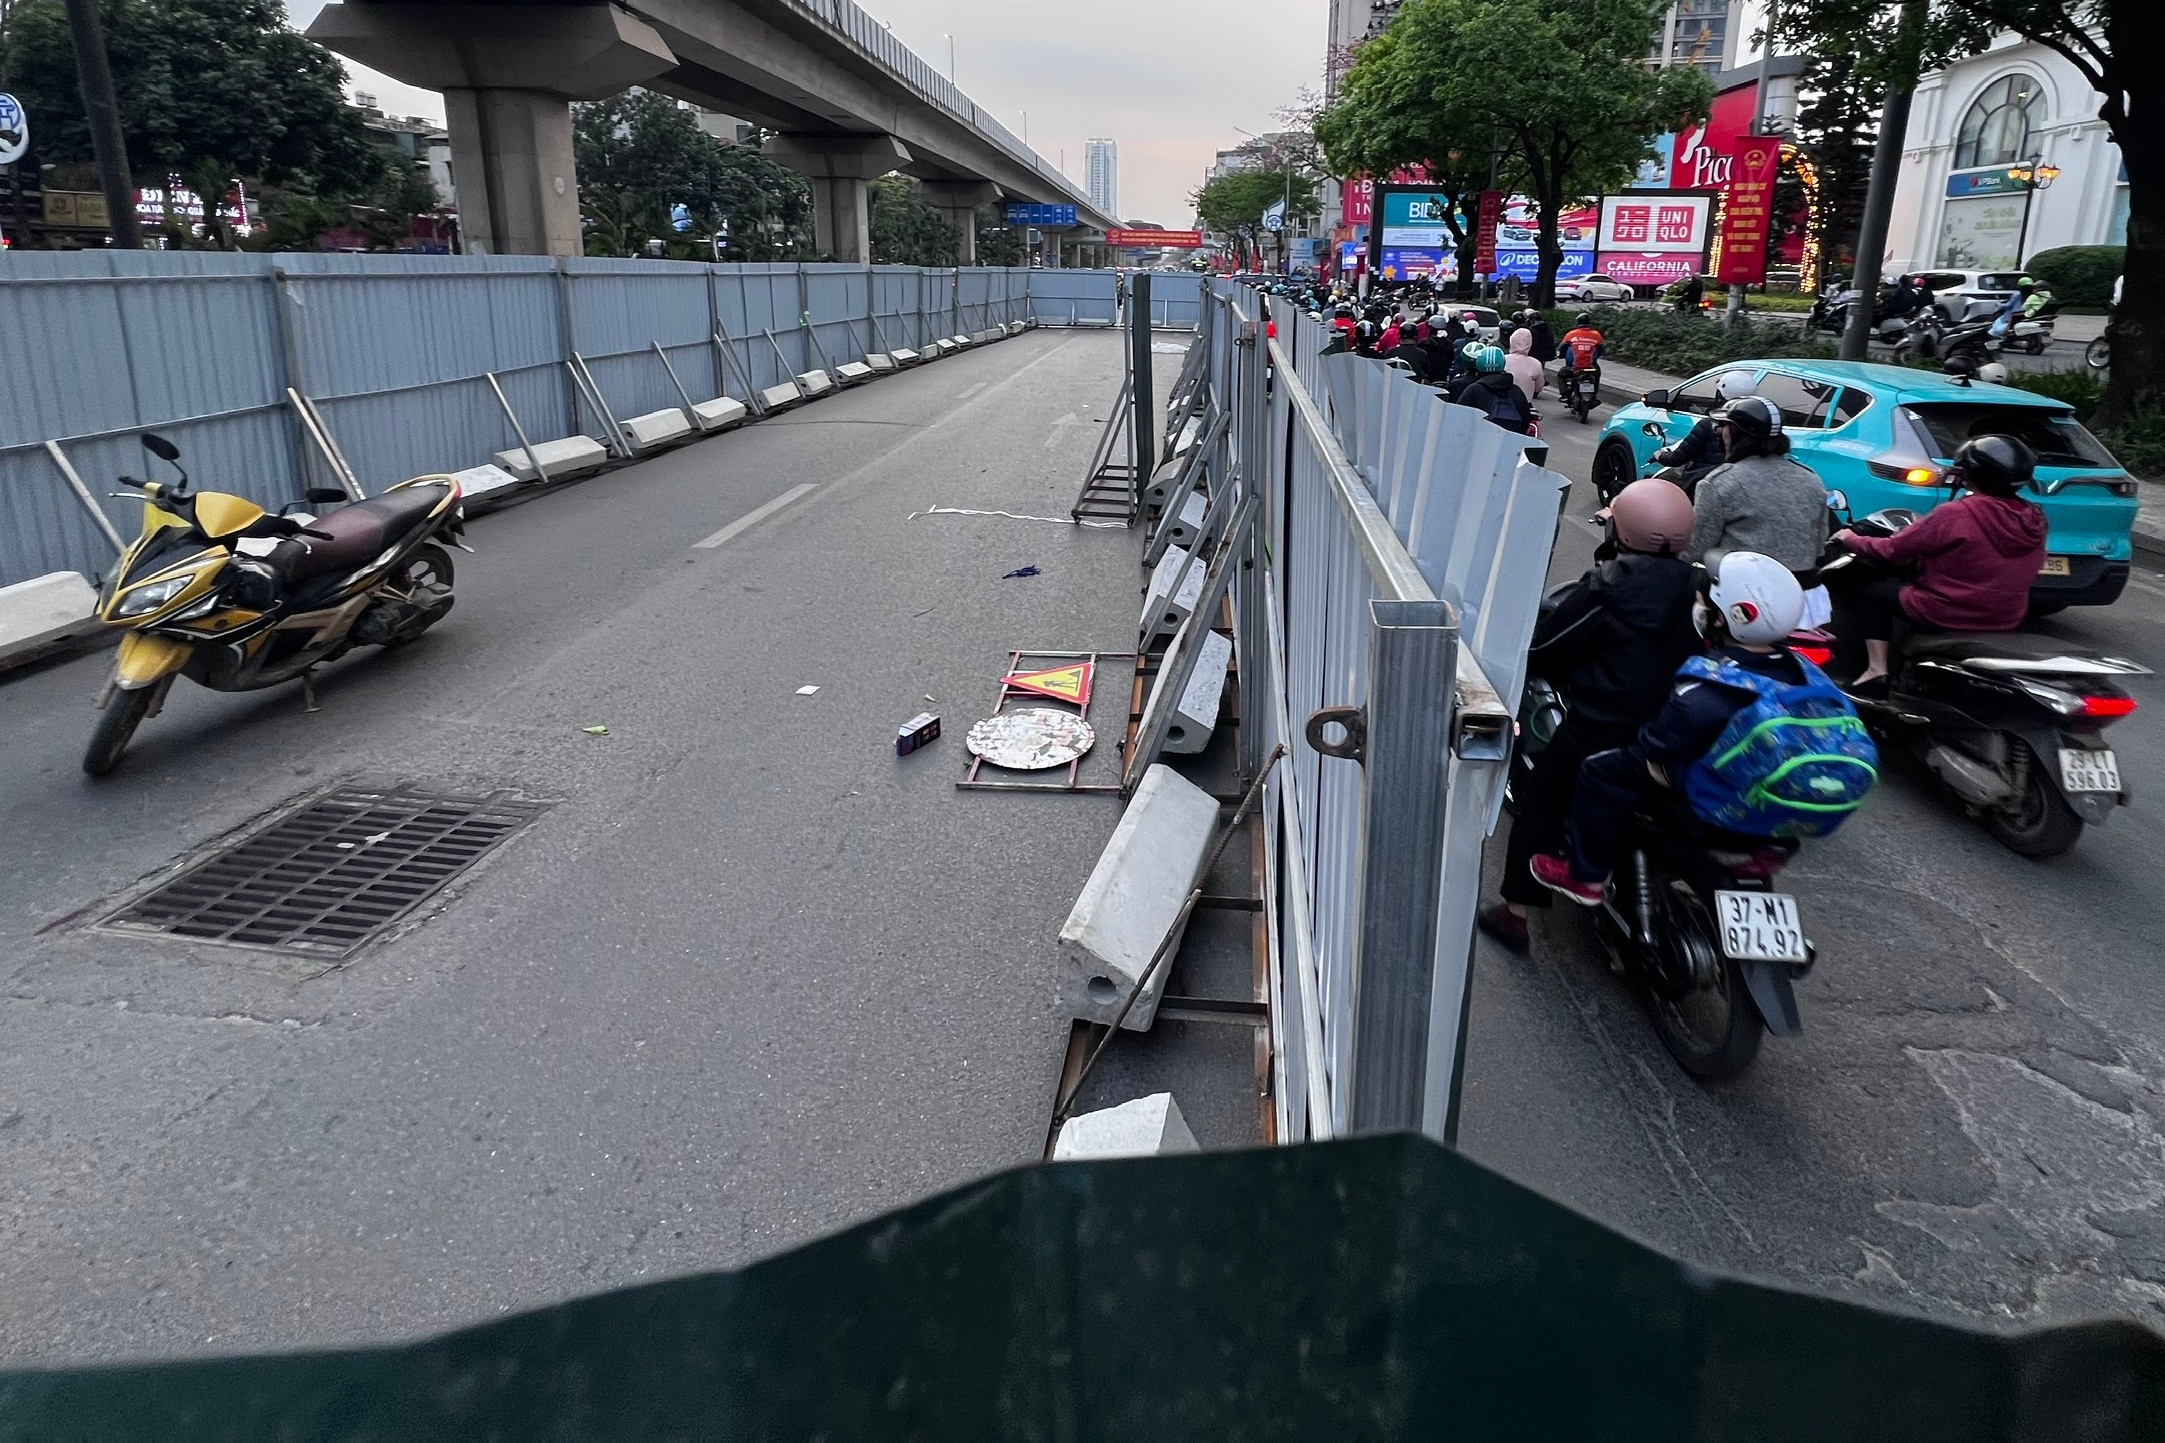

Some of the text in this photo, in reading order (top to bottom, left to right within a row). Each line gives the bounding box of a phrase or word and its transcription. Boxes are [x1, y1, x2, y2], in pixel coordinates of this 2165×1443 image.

[1409, 202, 1449, 218] BID
[1618, 210, 1646, 222] ユニ
[1661, 210, 1688, 224] UNI
[1659, 226, 1688, 240] QLO
[1516, 254, 1584, 266] DECON
[1606, 260, 1691, 272] CALIFORNIA
[2067, 750, 2110, 770] 29-L1
[2066, 770, 2117, 789] 596.03
[1727, 927, 1802, 956] 874.92
